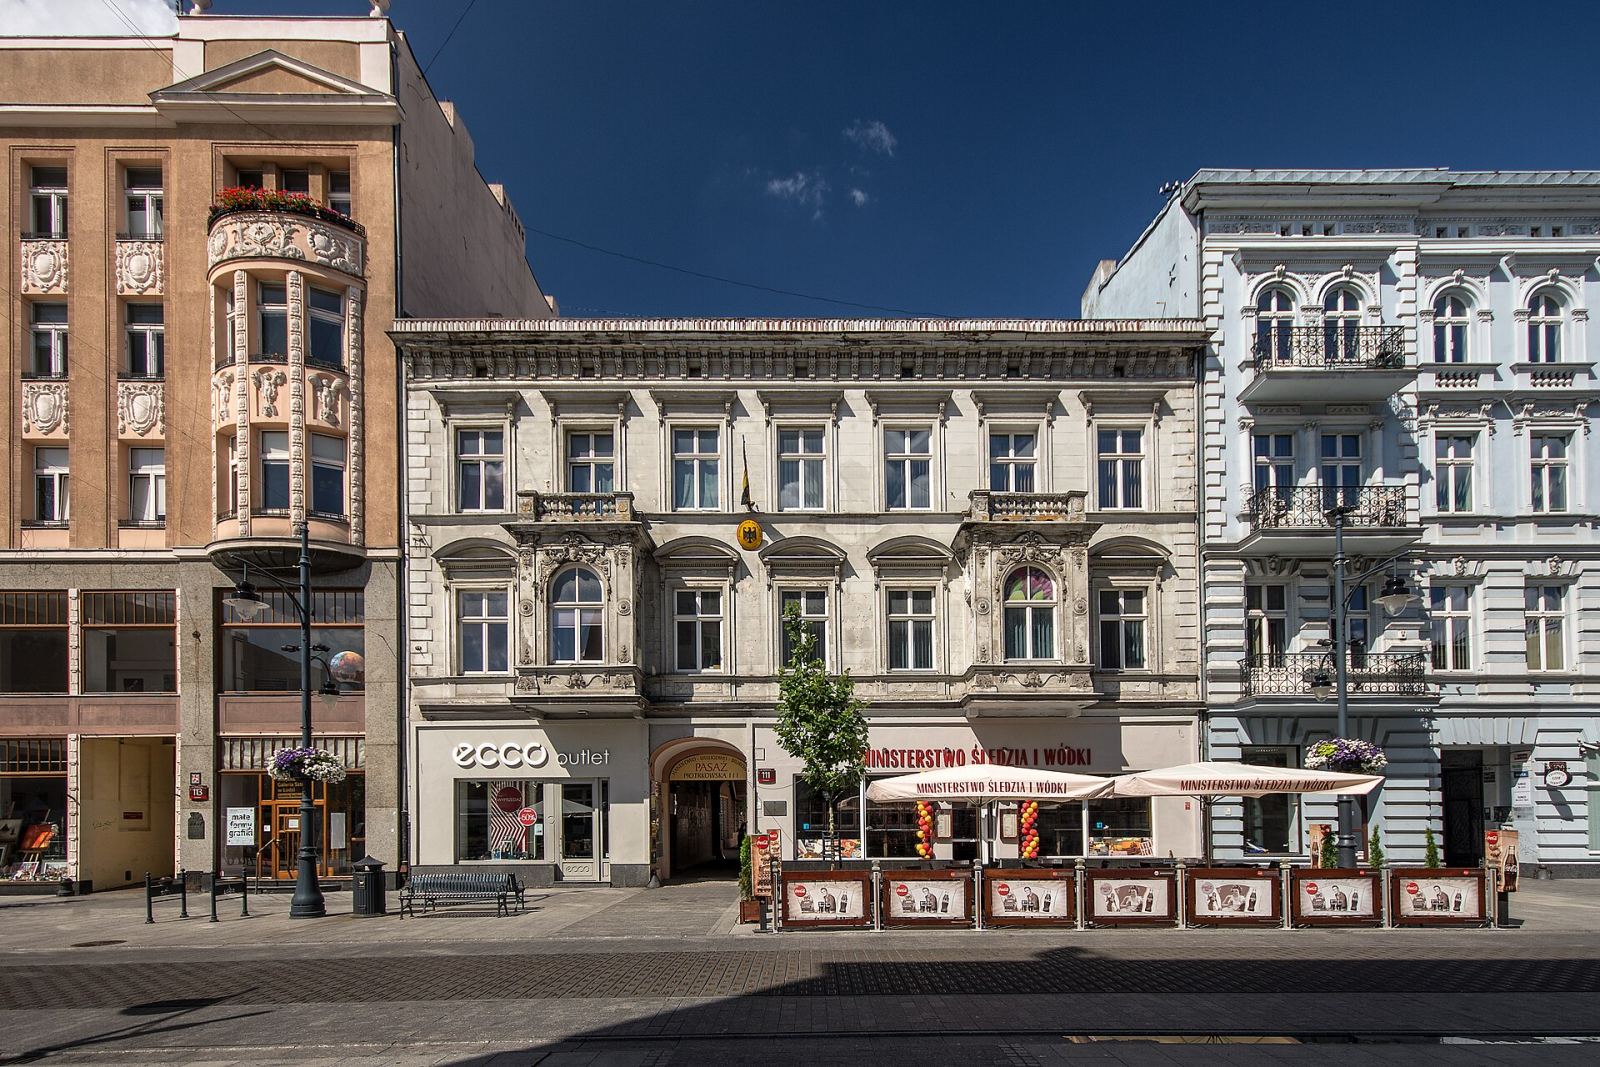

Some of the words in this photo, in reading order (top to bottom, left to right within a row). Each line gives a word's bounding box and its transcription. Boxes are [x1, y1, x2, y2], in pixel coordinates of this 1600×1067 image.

[452, 742, 549, 766] ecco
[557, 749, 610, 765] outlet
[971, 743, 1029, 766] ŚLEDZIA
[1033, 748, 1039, 766] I
[1044, 742, 1092, 766] WÓDKI
[695, 761, 729, 772] PASAŻ
[761, 771, 771, 779] 111
[917, 781, 985, 794] MINISTERSTWO
[988, 779, 1026, 793] ŚLEDZIA
[1029, 782, 1033, 793] I
[1036, 780, 1067, 794] WÓDKI
[1180, 779, 1251, 791] MINISTERSTWO
[1253, 777, 1292, 790] ŚLEDZIA
[1294, 780, 1300, 790] I
[1302, 779, 1336, 791] WÓDKI
[566, 865, 590, 873] ecco
